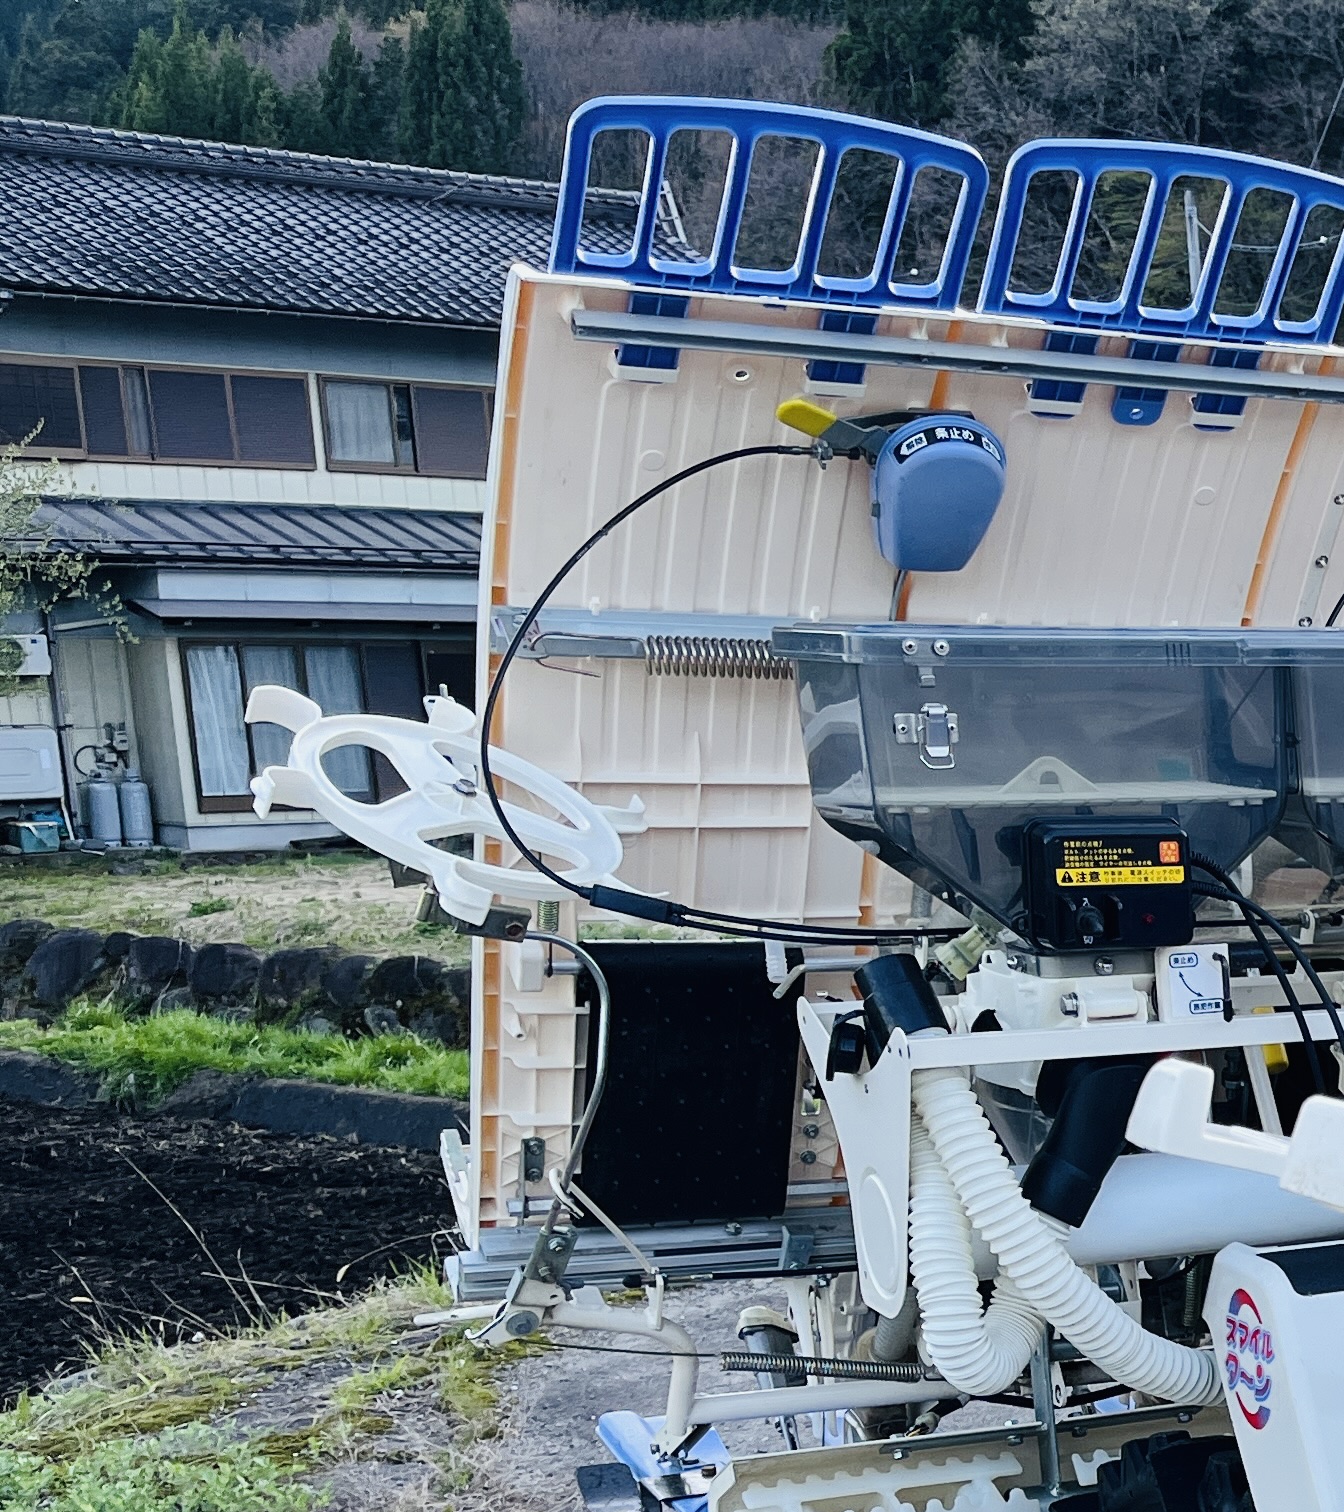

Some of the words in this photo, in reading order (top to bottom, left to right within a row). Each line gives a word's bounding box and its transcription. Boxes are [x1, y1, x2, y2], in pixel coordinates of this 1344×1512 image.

[934, 427, 975, 441] 条止め
[1075, 871, 1101, 883] 注意
[1226, 1315, 1275, 1364] スマイル
